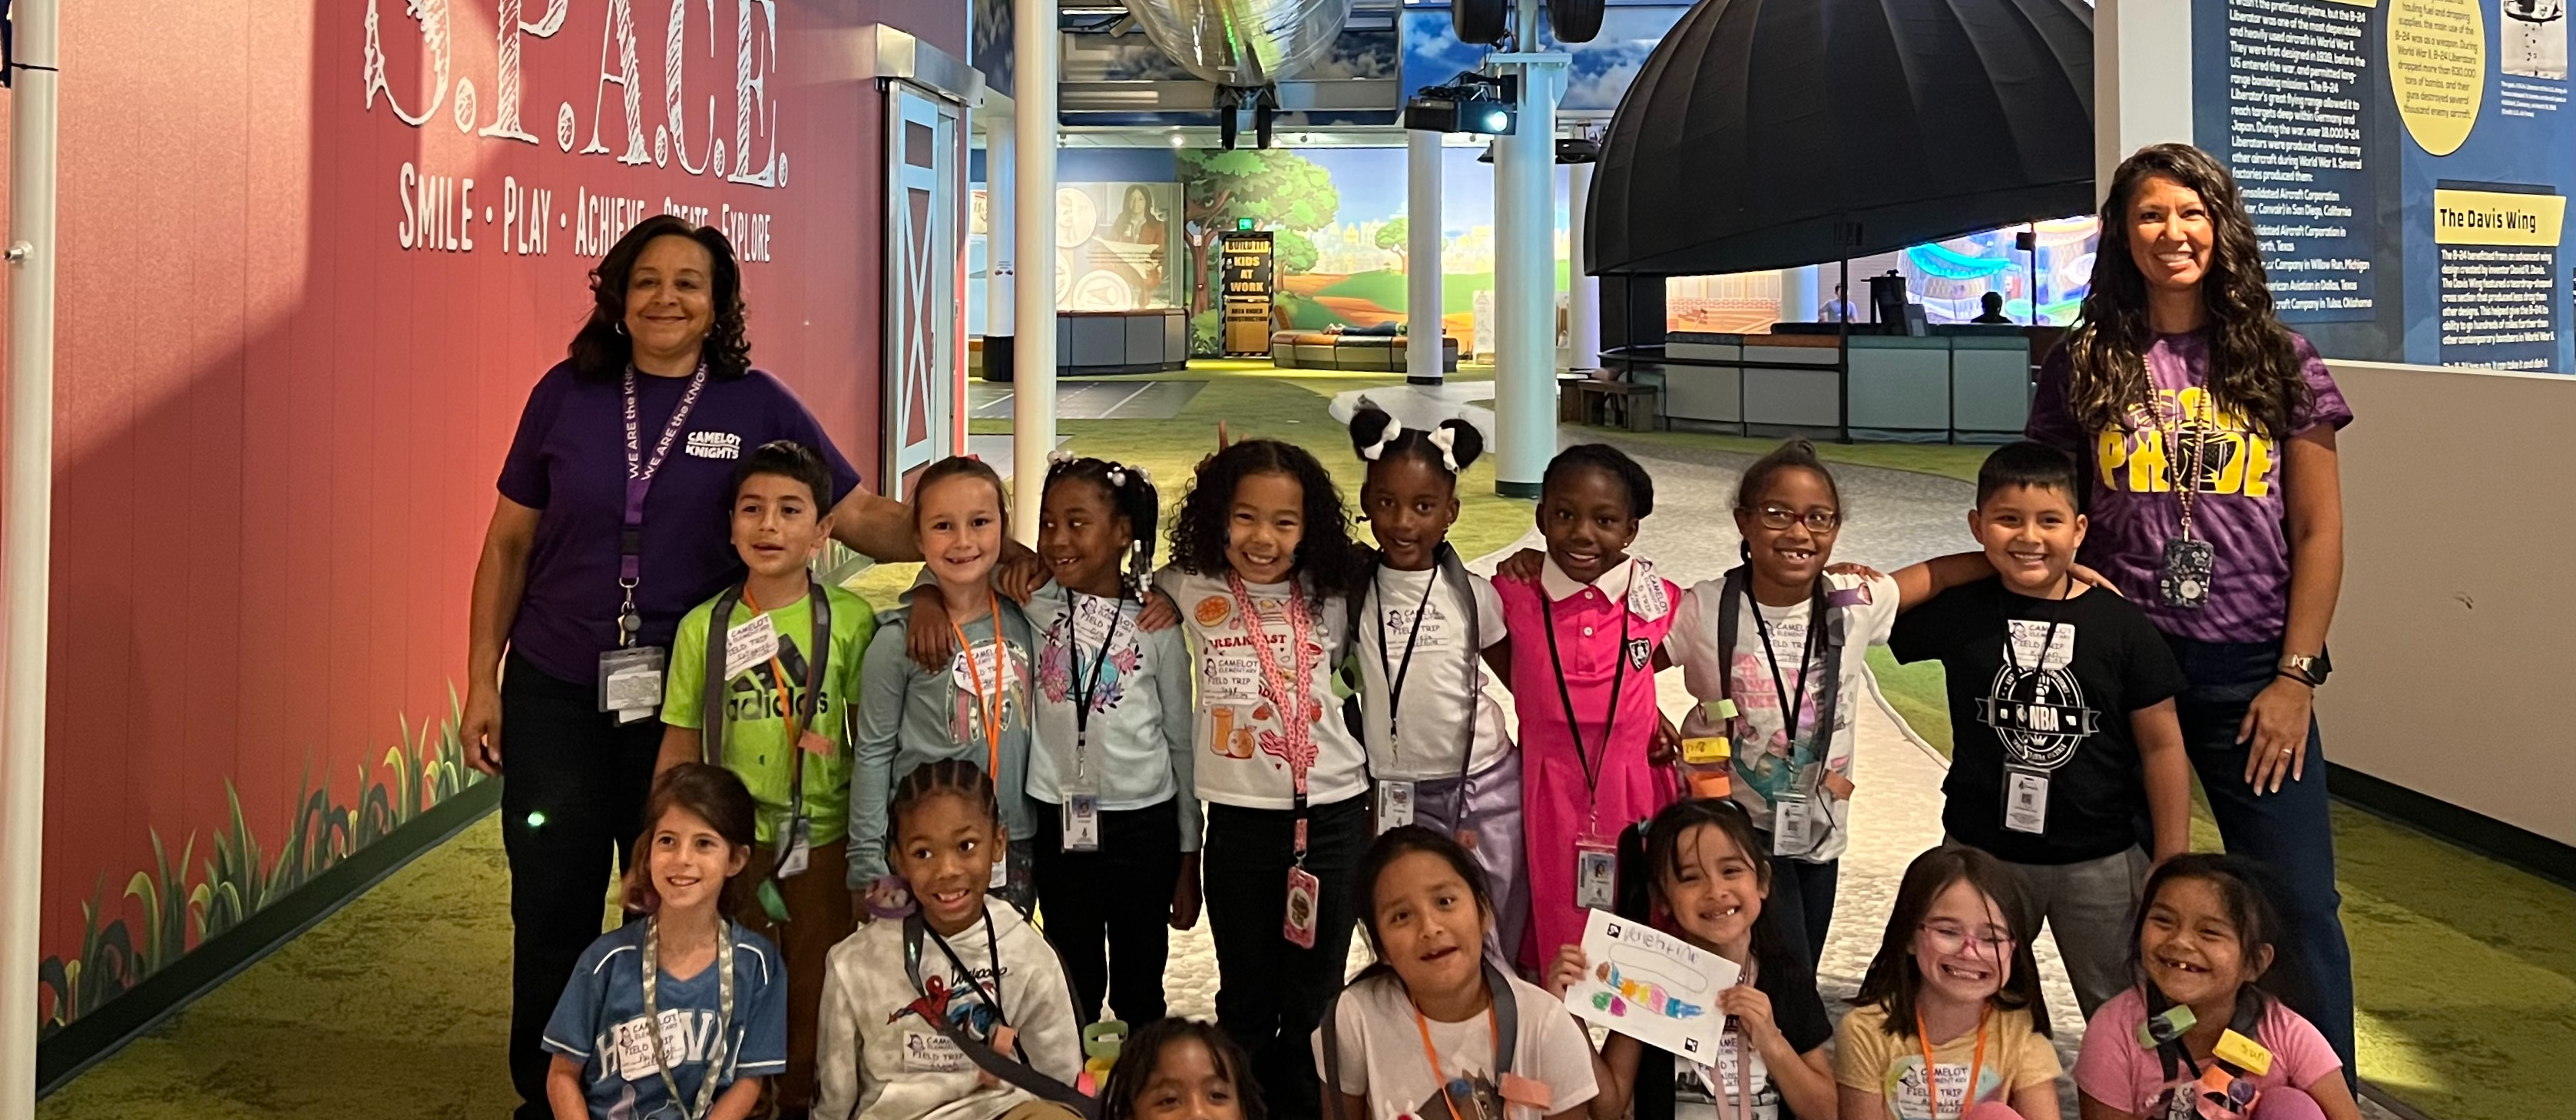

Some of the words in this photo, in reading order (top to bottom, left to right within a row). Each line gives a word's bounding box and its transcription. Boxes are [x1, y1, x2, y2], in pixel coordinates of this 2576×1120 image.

[2230, 10, 2260, 24] Liberator
[2263, 17, 2276, 26] was
[2278, 19, 2289, 28] one
[2298, 18, 2308, 30] the
[2309, 22, 2325, 32] most
[2328, 8, 2338, 19] but
[2339, 9, 2349, 21] the
[2350, 11, 2366, 23] B-24
[2435, 8, 2445, 17] and
[2424, 21, 2432, 29] the
[2230, 28, 2243, 38] and
[2244, 28, 2268, 44] heavily
[2269, 32, 2285, 42] used
[2286, 33, 2309, 45] aircraft
[2317, 36, 2336, 48] World
[2336, 38, 2349, 50] War
[2396, 31, 2409, 41] B-24
[2230, 41, 2247, 56] They
[2249, 46, 2266, 55] were
[2267, 45, 2280, 57] first
[2281, 47, 2309, 62] designed
[2334, 53, 2354, 65] before
[2356, 56, 2366, 67] the
[2397, 45, 2414, 56] World
[2416, 49, 2427, 58] War
[2243, 59, 2269, 71] entered
[2270, 61, 2280, 72] the
[2297, 65, 2309, 76] and
[2231, 75, 2250, 88] range
[2252, 75, 2280, 91] bombing
[2310, 81, 2321, 91] The
[2323, 81, 2339, 93] B-24
[2231, 89, 2267, 102] Liberator's
[2269, 94, 2286, 106] great
[2287, 94, 2303, 109] flying
[2304, 98, 2323, 110] range
[2231, 106, 2250, 116] reach
[2252, 106, 2276, 121] targets
[2277, 108, 2293, 123] deep
[2295, 110, 2313, 121] within
[2315, 111, 2342, 128] Germany
[2343, 114, 2355, 125] and
[2256, 122, 2278, 137] During
[2280, 124, 2290, 134] the
[2306, 128, 2320, 137] over
[2344, 128, 2359, 140] B-24
[2232, 136, 2266, 148] Liberators
[2268, 141, 2285, 150] were
[2318, 144, 2334, 153] more
[2335, 142, 2349, 154] than
[2350, 146, 2361, 157] any
[2232, 152, 2250, 164] other
[2251, 154, 2276, 164] aircraft
[2278, 154, 2299, 169] during
[2300, 156, 2317, 167] World
[2319, 157, 2331, 167] War
[2339, 157, 2362, 169] Several
[2233, 167, 2262, 179] factories
[2263, 170, 2294, 183] produced
[2280, 188, 2303, 200] Aircraft
[399, 162, 474, 252] SMILE
[504, 175, 551, 255] PLAY
[2440, 208, 2464, 227] The
[2468, 207, 2502, 229] Davis
[2506, 209, 2536, 234] Wing
[2280, 225, 2303, 236] Aircraft
[1233, 256, 1260, 267] KIDS
[1240, 269, 1253, 279] AT
[1230, 282, 1264, 292] WORK
[625, 397, 635, 419] the
[627, 422, 637, 449] ARE
[641, 458, 661, 480] WE
[657, 428, 677, 456] ARE
[671, 406, 688, 427] the
[688, 432, 741, 446] CAMELOT
[685, 445, 739, 459] KNIGHTS
[628, 453, 638, 479] WE
[1649, 575, 1668, 612] CAMELOT
[731, 616, 768, 637] CAMELOT
[1392, 627, 1411, 635] FIEL
[2015, 640, 2039, 648] FIELD
[2030, 706, 2059, 731] NBA
[1921, 1067, 1967, 1076] CMELOT
[1907, 1088, 1929, 1096] FIEL
